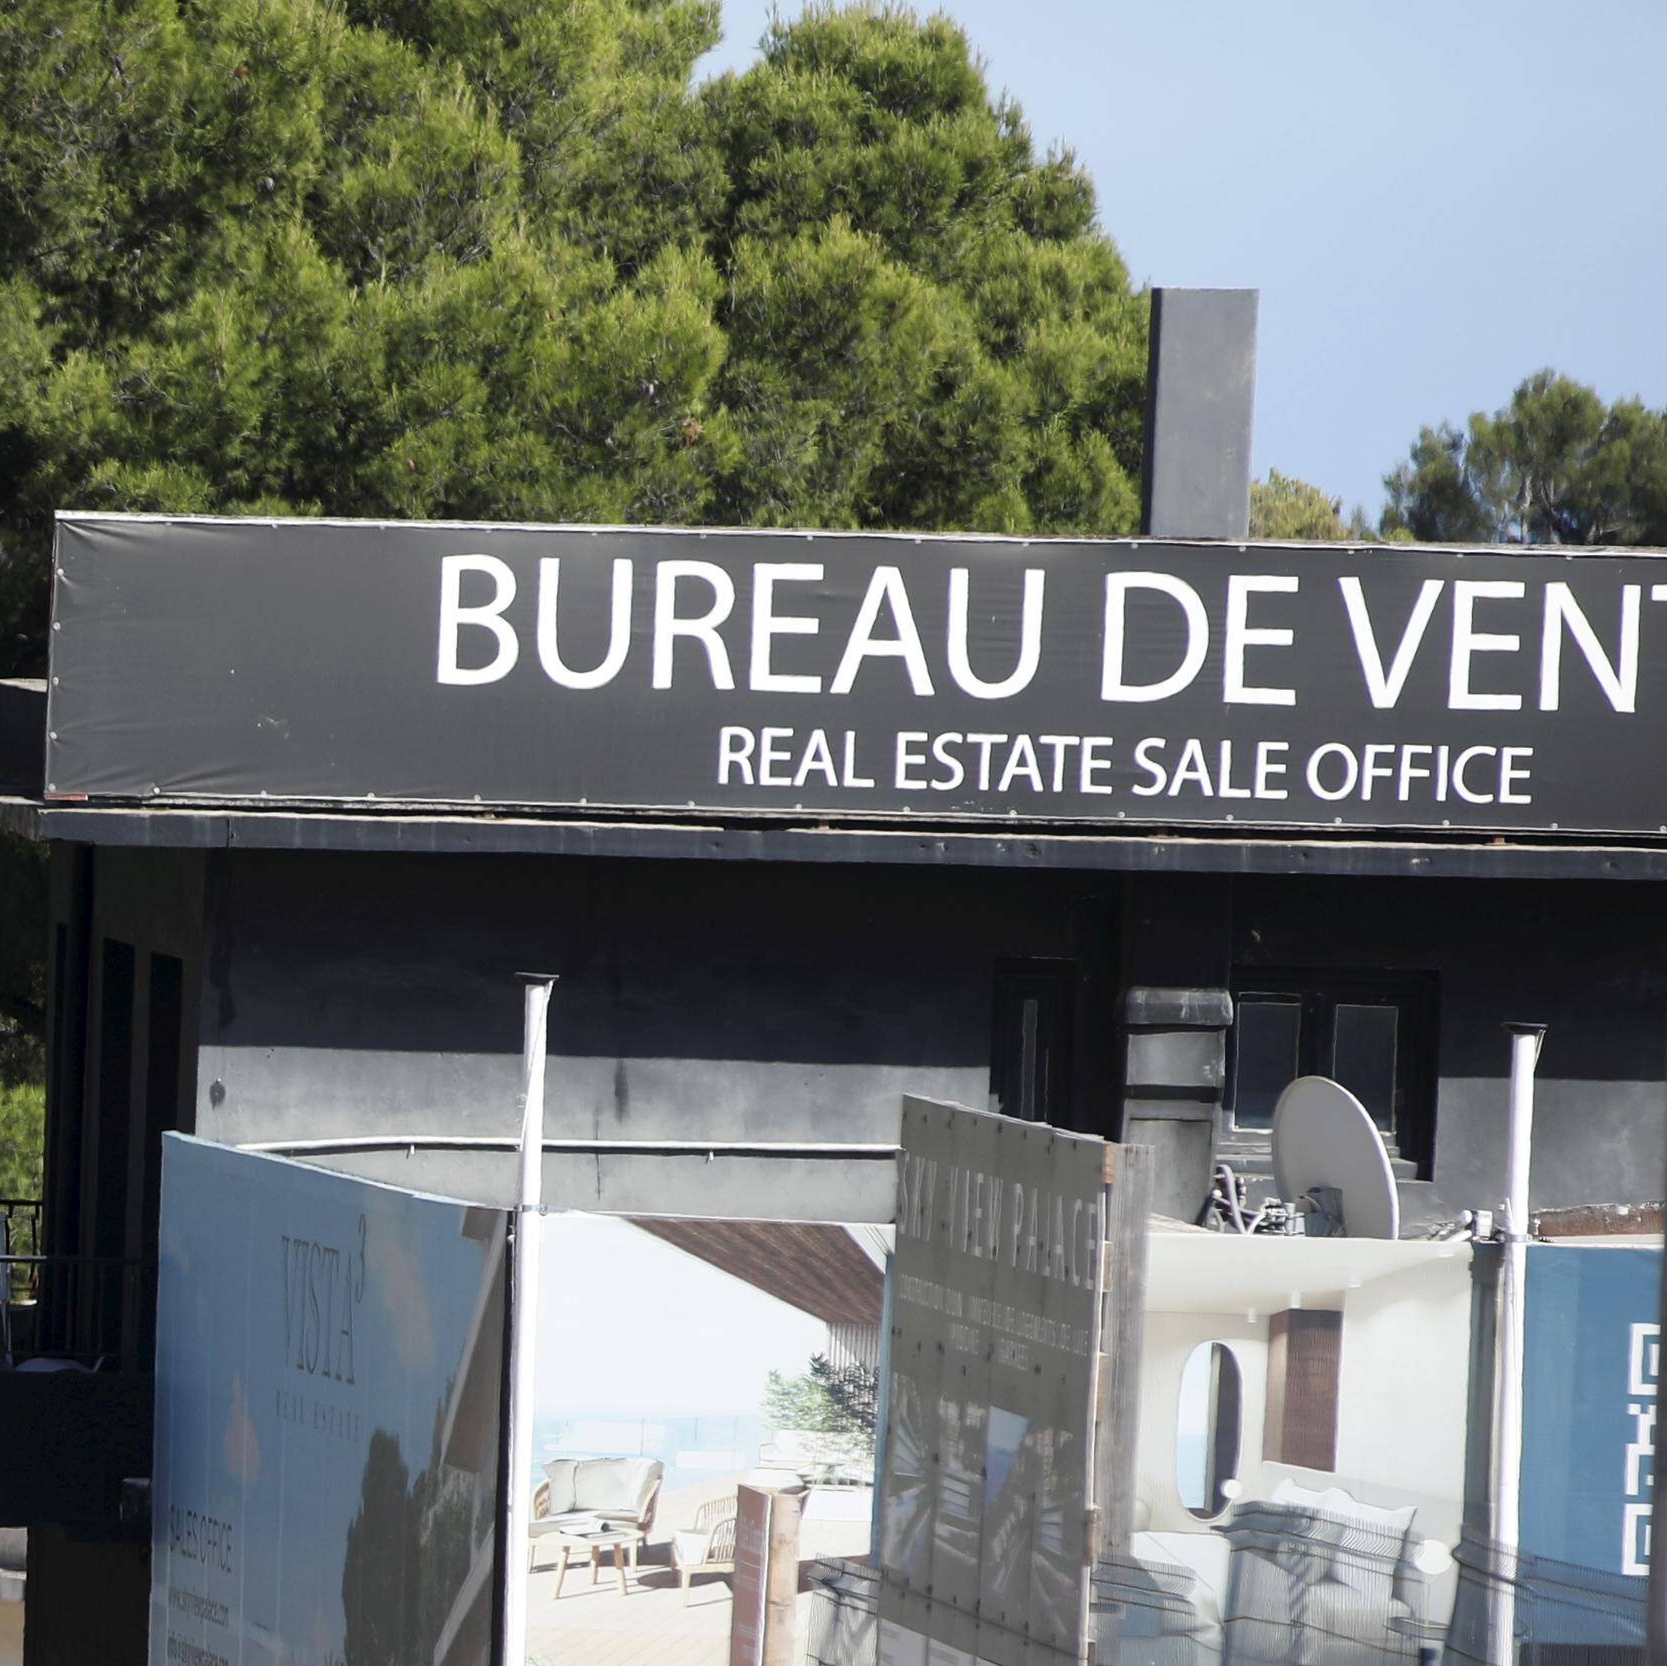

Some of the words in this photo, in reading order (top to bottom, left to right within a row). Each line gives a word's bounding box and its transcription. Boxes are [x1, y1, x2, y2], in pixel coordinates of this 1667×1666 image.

[436, 552, 1046, 702] BUREAU
[1099, 570, 1300, 706] DE
[1337, 575, 1667, 714] VEN
[717, 726, 876, 789] REAL
[895, 731, 1114, 796] ESTATE
[1131, 737, 1289, 800] SALE
[1306, 742, 1535, 804] OFFICE
[1012, 1182, 1096, 1291] PALACE
